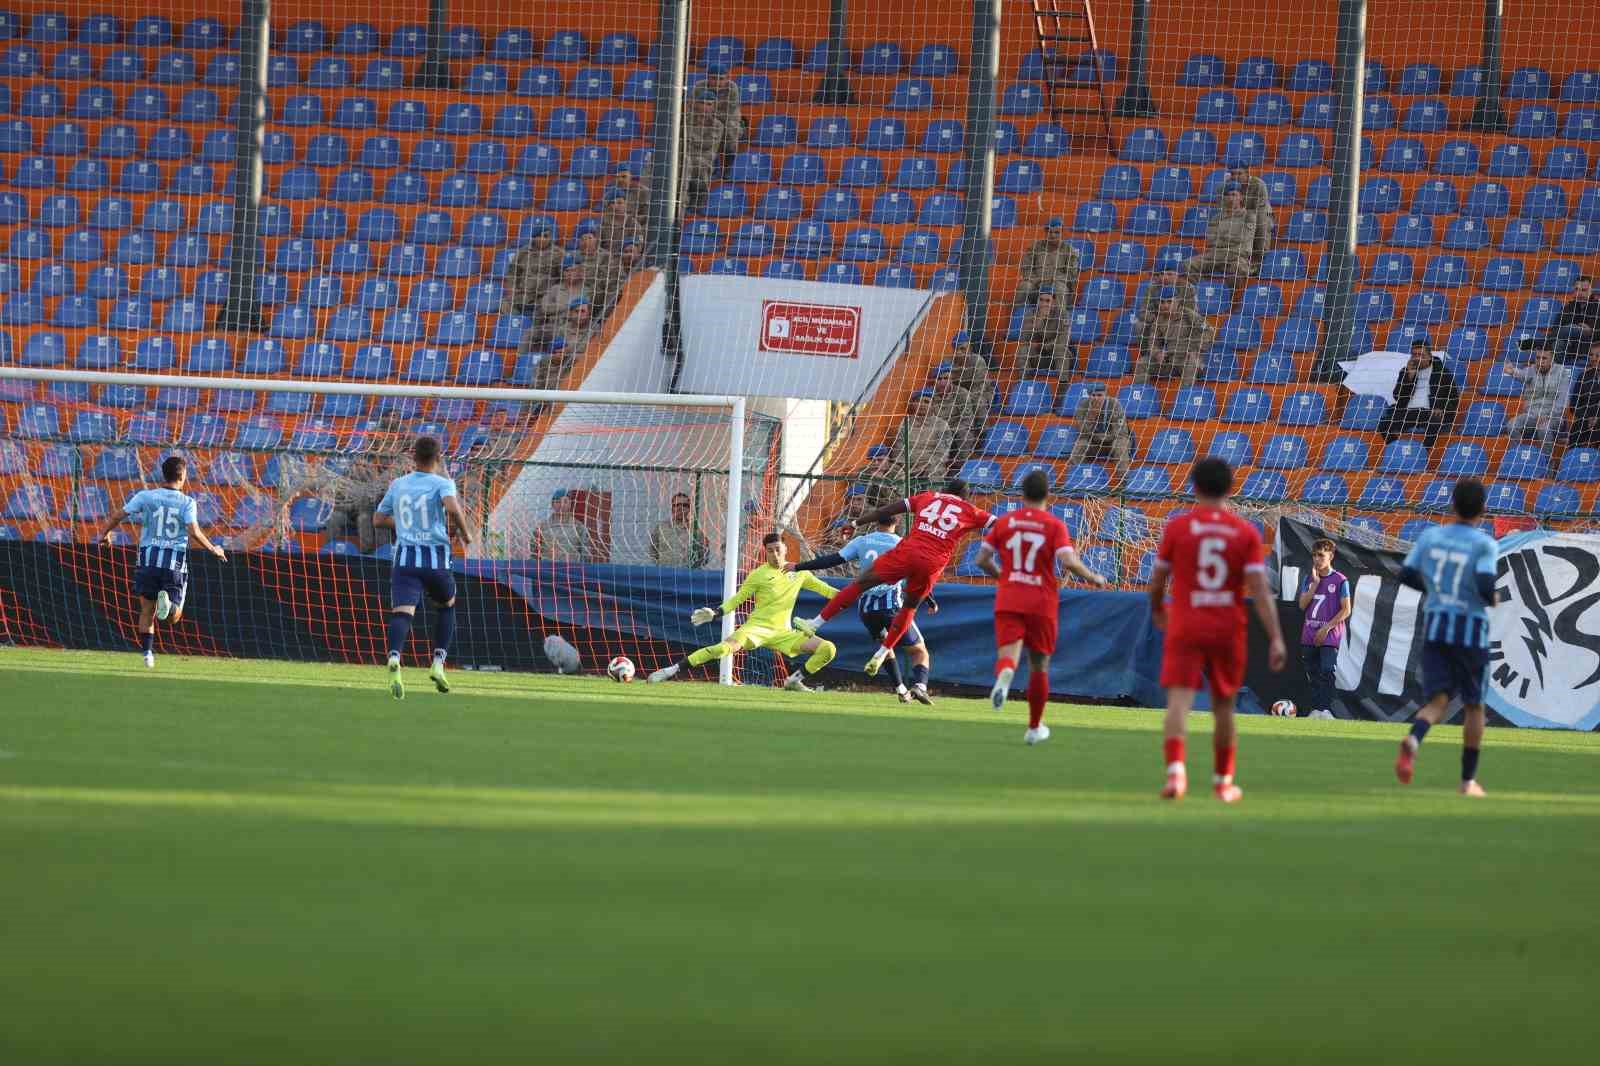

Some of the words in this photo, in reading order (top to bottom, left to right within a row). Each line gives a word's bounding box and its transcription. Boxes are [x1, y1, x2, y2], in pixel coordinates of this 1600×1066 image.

[817, 327, 828, 335] VE
[153, 506, 180, 539] 15
[399, 494, 430, 529] 61
[919, 499, 962, 531] 45
[918, 522, 949, 540] BOAKYE
[1005, 531, 1046, 573] 17
[1197, 538, 1229, 591] 5
[1429, 547, 1468, 598] 77
[1312, 593, 1327, 618] 7
